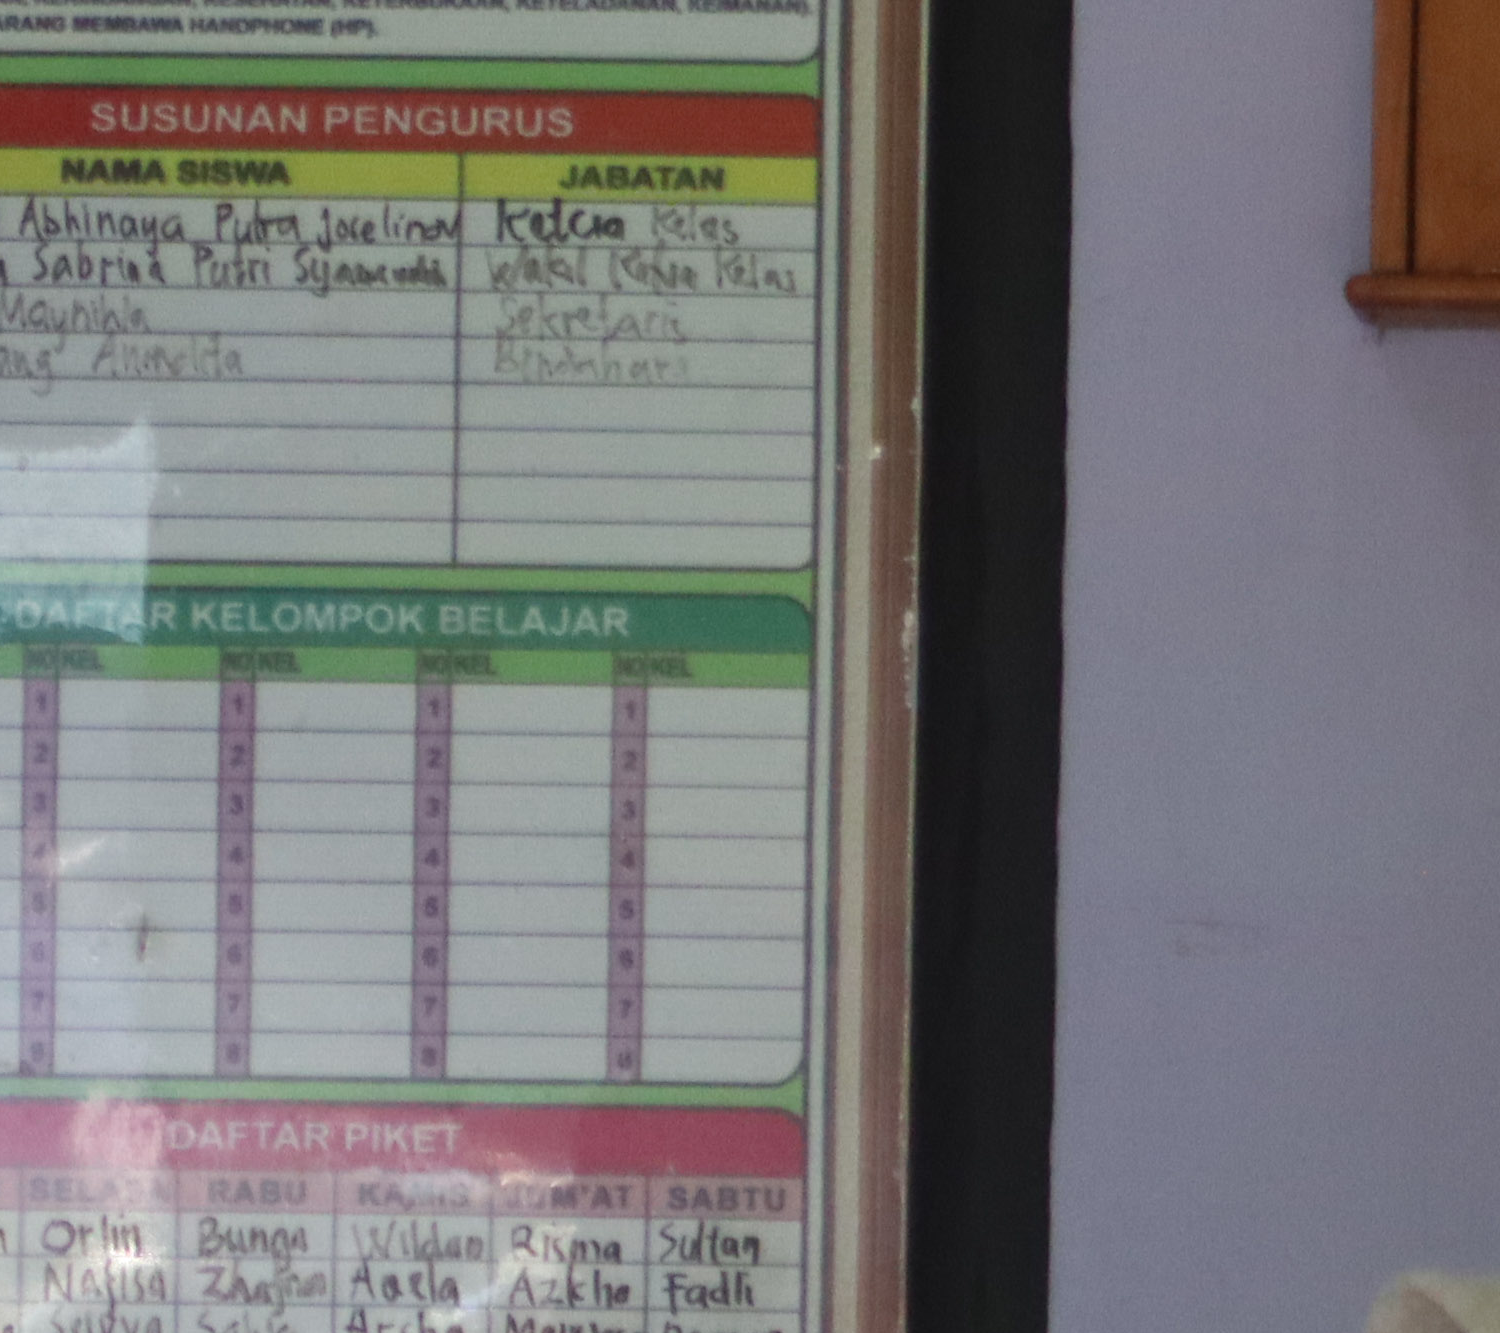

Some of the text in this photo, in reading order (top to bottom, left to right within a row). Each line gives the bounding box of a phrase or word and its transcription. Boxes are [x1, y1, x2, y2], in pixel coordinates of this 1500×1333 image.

[90, 103, 575, 138] SUSUNAN PENGURUS
[61, 159, 290, 187] NAMA SISWA
[559, 165, 726, 192] JABATAN
[15, 600, 630, 638] DAFTAR KELOMPOK BELAJAR
[166, 1121, 463, 1155] DAFTAR PIKET
[206, 1178, 307, 1204] RABU
[668, 1186, 787, 1212] SABTU
